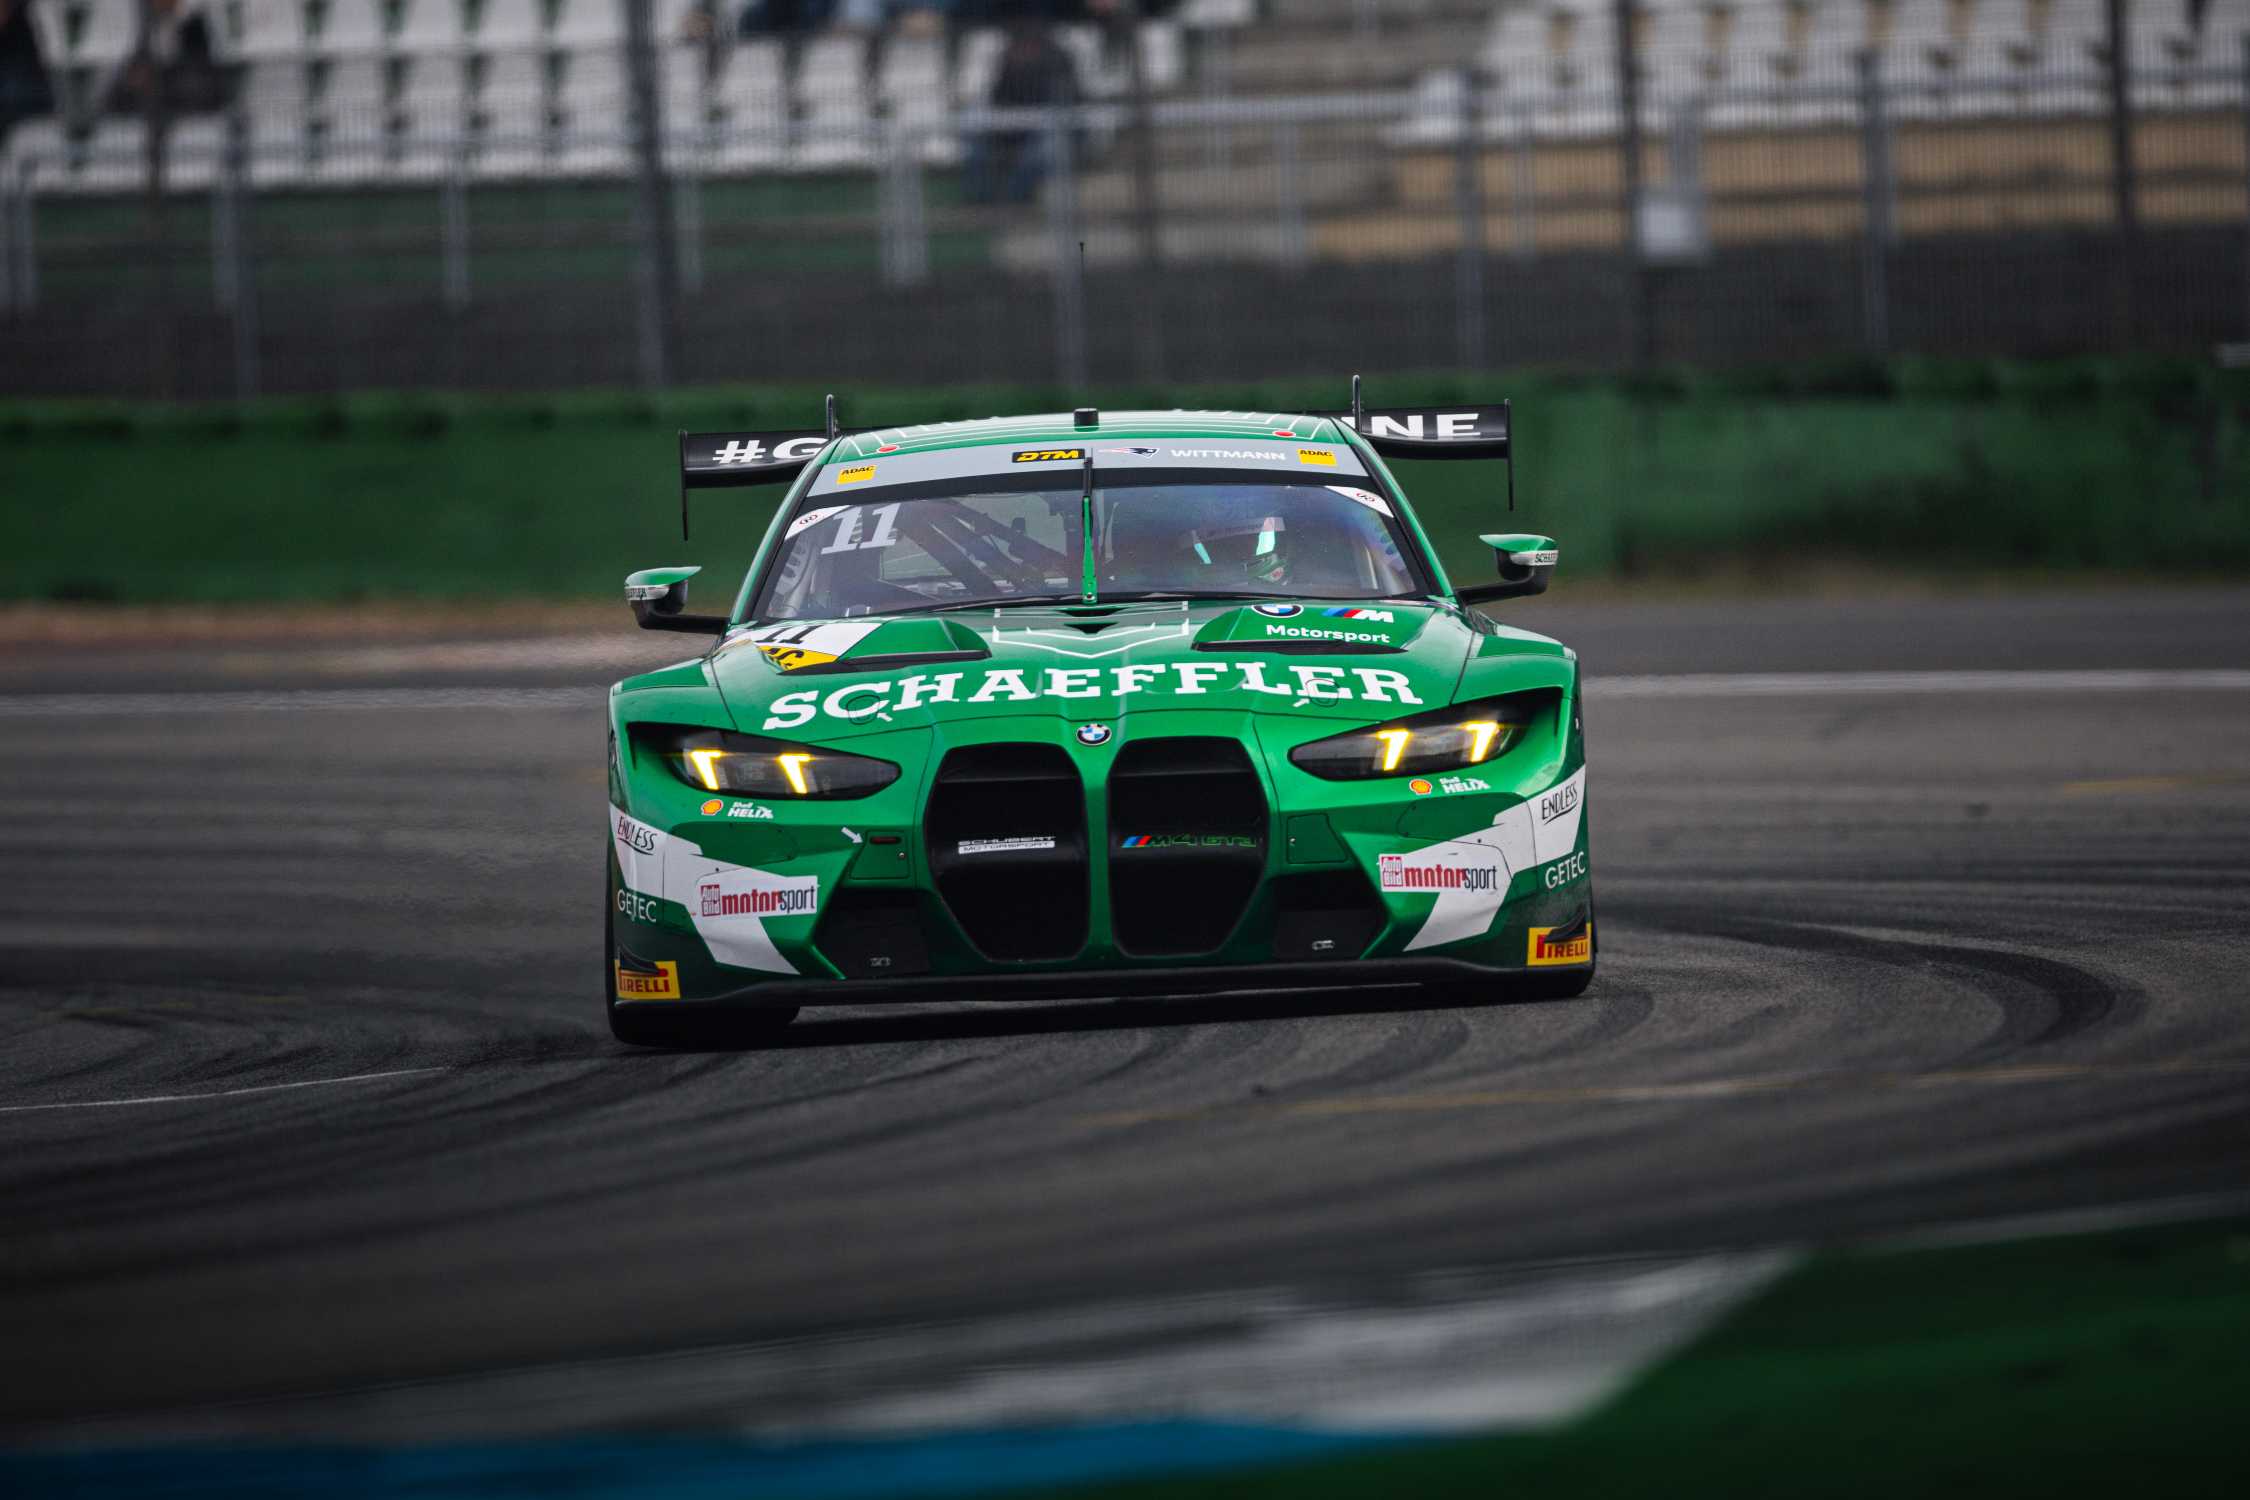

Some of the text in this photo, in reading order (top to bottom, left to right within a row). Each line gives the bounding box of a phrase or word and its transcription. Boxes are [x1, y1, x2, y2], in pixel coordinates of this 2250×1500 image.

[1016, 449, 1079, 461] DTM
[1170, 448, 1286, 460] WITTMANN
[1299, 449, 1333, 457] ADAC
[841, 465, 874, 475] ADAC
[821, 502, 901, 555] 11
[1352, 609, 1394, 623] M
[754, 625, 824, 644] 11
[1265, 624, 1390, 643] Motorsport
[761, 661, 1423, 730] SCHAEFFLER
[1442, 778, 1491, 794] HELIX
[1541, 781, 1578, 820] ENDLESS
[727, 805, 773, 819] HELIX
[617, 816, 658, 851] ENDLESS
[1404, 864, 1497, 892] motorsport
[1545, 851, 1586, 889] GETEC
[617, 889, 656, 923] GETEC
[721, 885, 815, 913] motorsport
